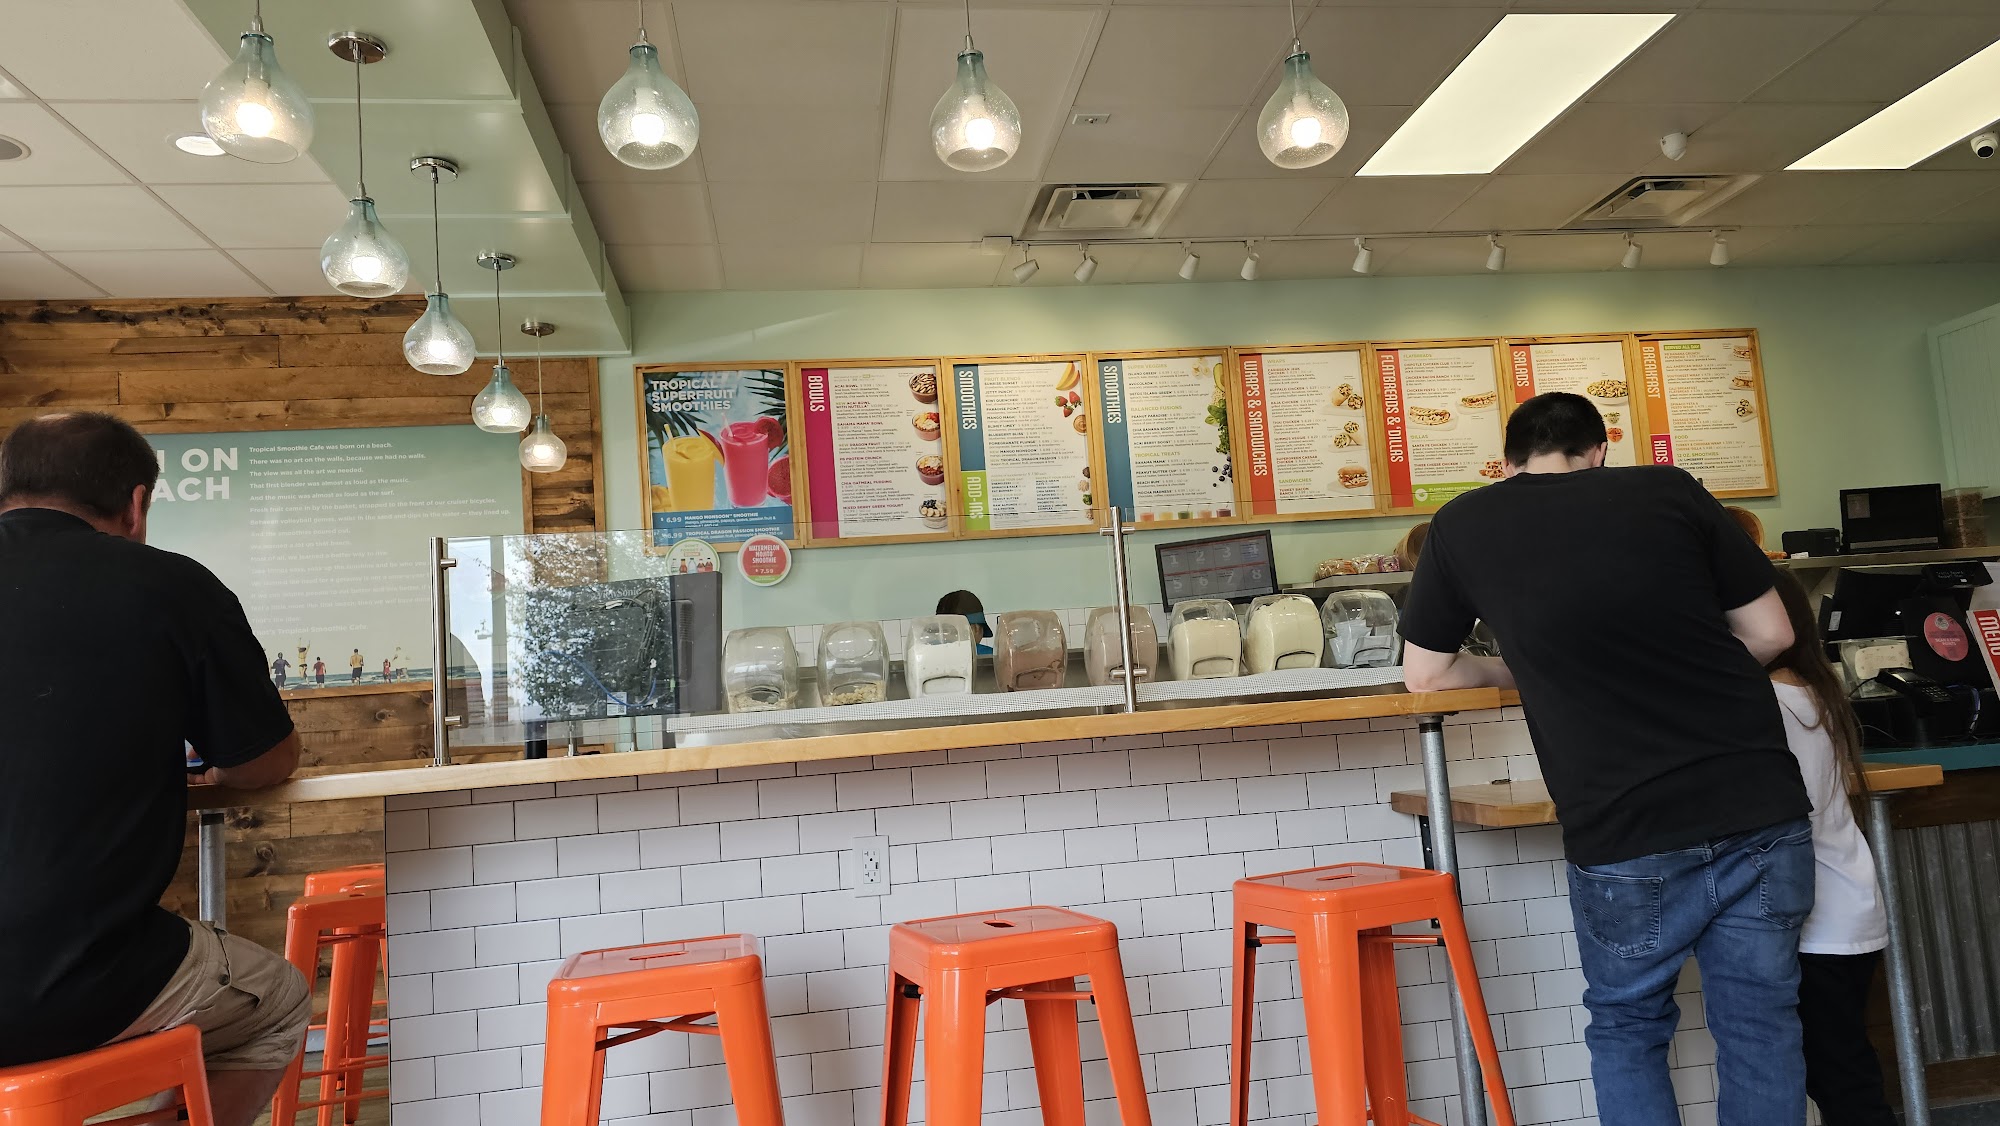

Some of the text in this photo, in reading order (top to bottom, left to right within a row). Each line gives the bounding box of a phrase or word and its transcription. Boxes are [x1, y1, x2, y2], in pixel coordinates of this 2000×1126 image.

[1513, 350, 1529, 387] SALADS
[1642, 346, 1660, 398] BREAKFAST
[651, 379, 718, 391] TROPICAL
[652, 389, 735, 402] SUPERFRUIT
[808, 375, 825, 412] BOWLS
[959, 370, 977, 430] SMOOTHIES
[1104, 365, 1121, 424] SMOOTHIES
[1381, 355, 1399, 414] FLATBREADS
[652, 401, 731, 412] SMOOTHIES
[1243, 360, 1267, 477] WRAPS & SANDWICHES
[1387, 416, 1400, 425] &
[181, 447, 238, 473] ON
[249, 446, 275, 454] Tropical
[1654, 440, 1668, 463] KIDS
[151, 476, 230, 502] ACH
[967, 476, 984, 519] ADD-INS
